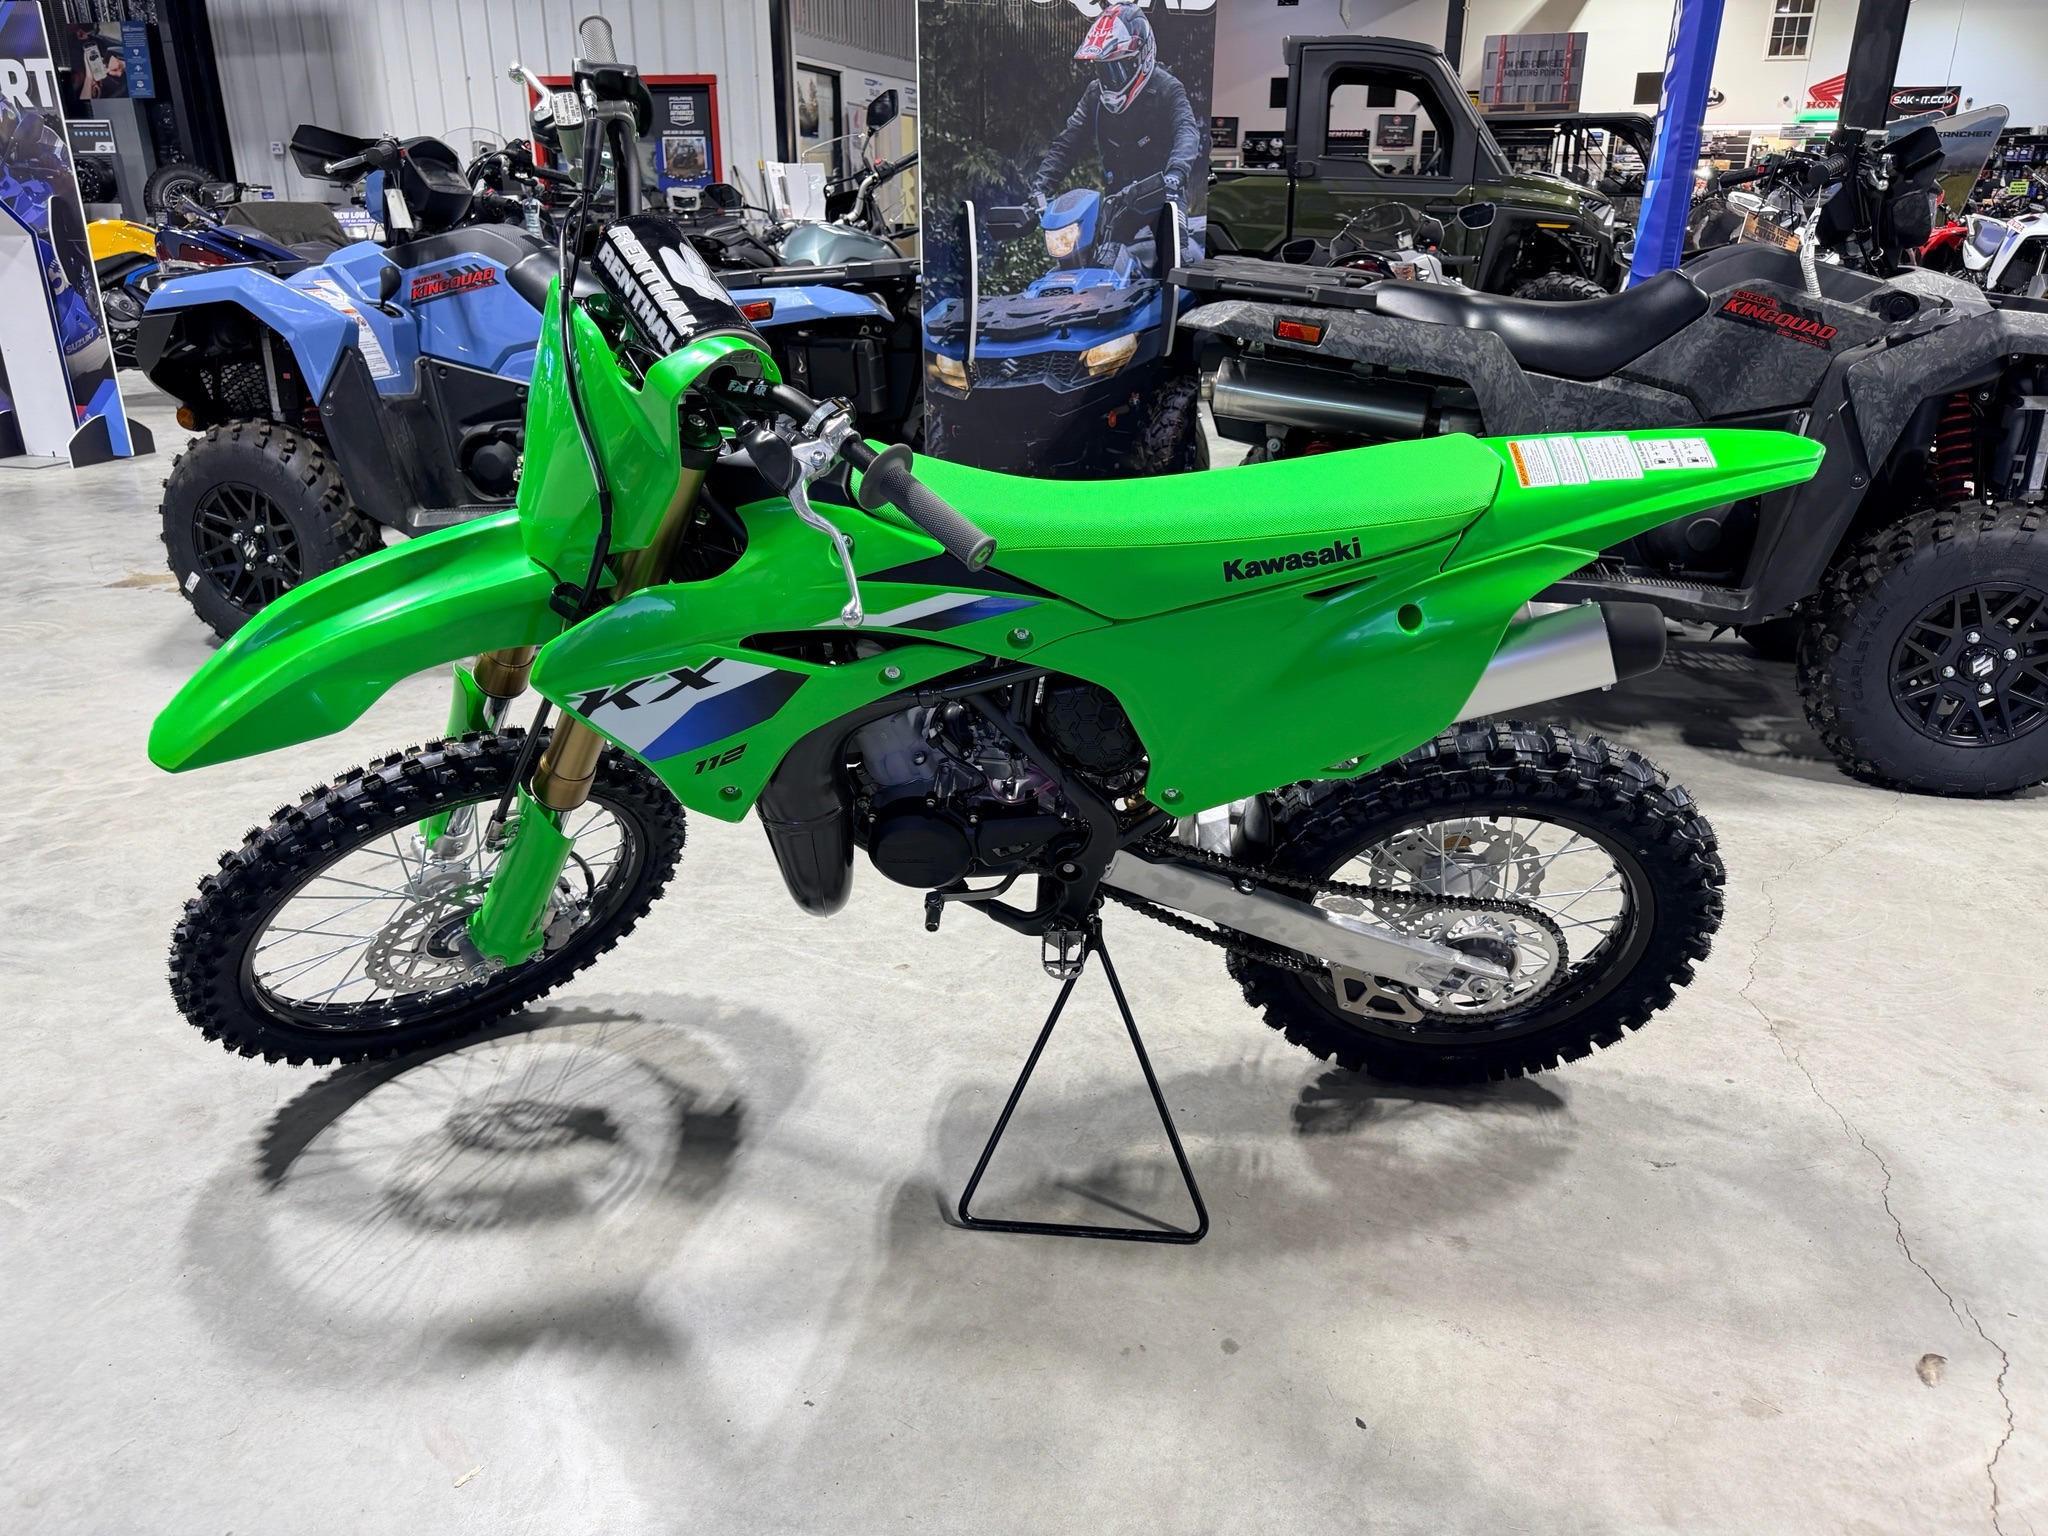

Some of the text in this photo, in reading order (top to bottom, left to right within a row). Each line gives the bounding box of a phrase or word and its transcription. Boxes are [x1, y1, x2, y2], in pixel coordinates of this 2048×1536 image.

[1504, 68, 1565, 77] MOUNTING POINTS
[1805, 101, 1842, 109] HON
[1938, 130, 1992, 138] RANCHER
[411, 267, 496, 300] KINGQUAD
[597, 241, 677, 355] RENTHAL
[607, 225, 698, 337] RENTHAL
[1737, 290, 1775, 306] SUZUKI
[1724, 298, 1839, 340] KINGQUAD
[65, 328, 95, 354] SUZUKI
[1222, 536, 1362, 583] Kawasaki
[1851, 605, 1889, 700] CARLSTAR
[576, 656, 726, 718] KX
[694, 742, 748, 776] 112
